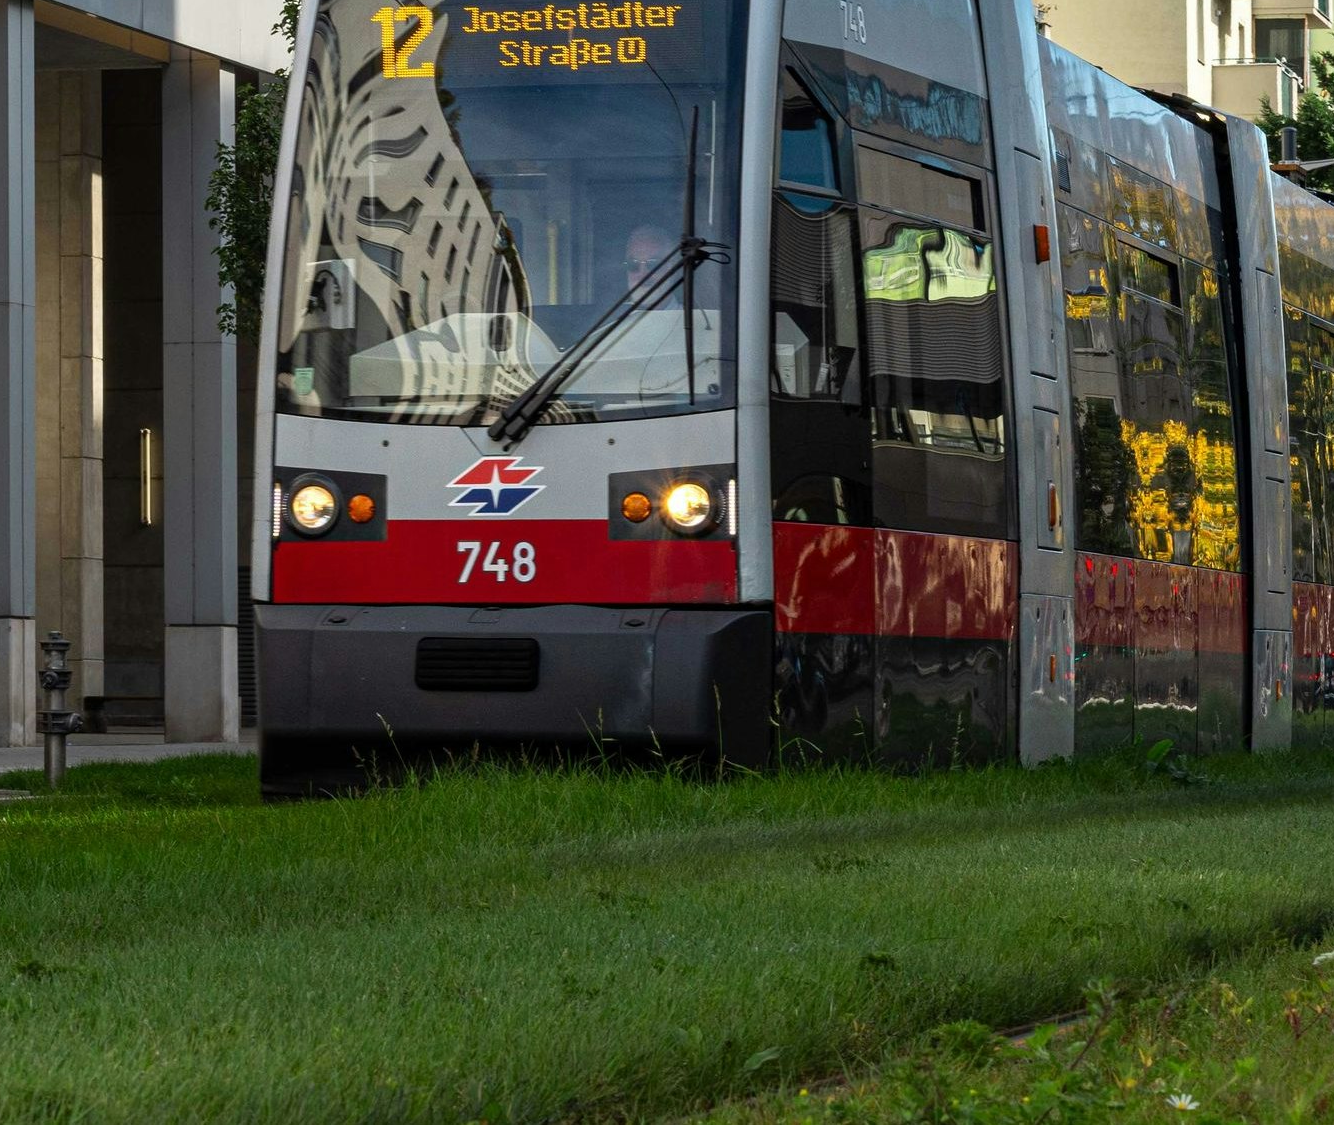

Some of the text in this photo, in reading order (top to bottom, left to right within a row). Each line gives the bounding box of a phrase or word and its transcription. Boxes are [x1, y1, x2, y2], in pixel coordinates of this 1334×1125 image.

[462, 1, 682, 33] Josefstädter
[839, 0, 867, 44] 748
[370, 6, 434, 78] 12
[499, 38, 612, 70] Straße
[457, 541, 536, 583] 748
